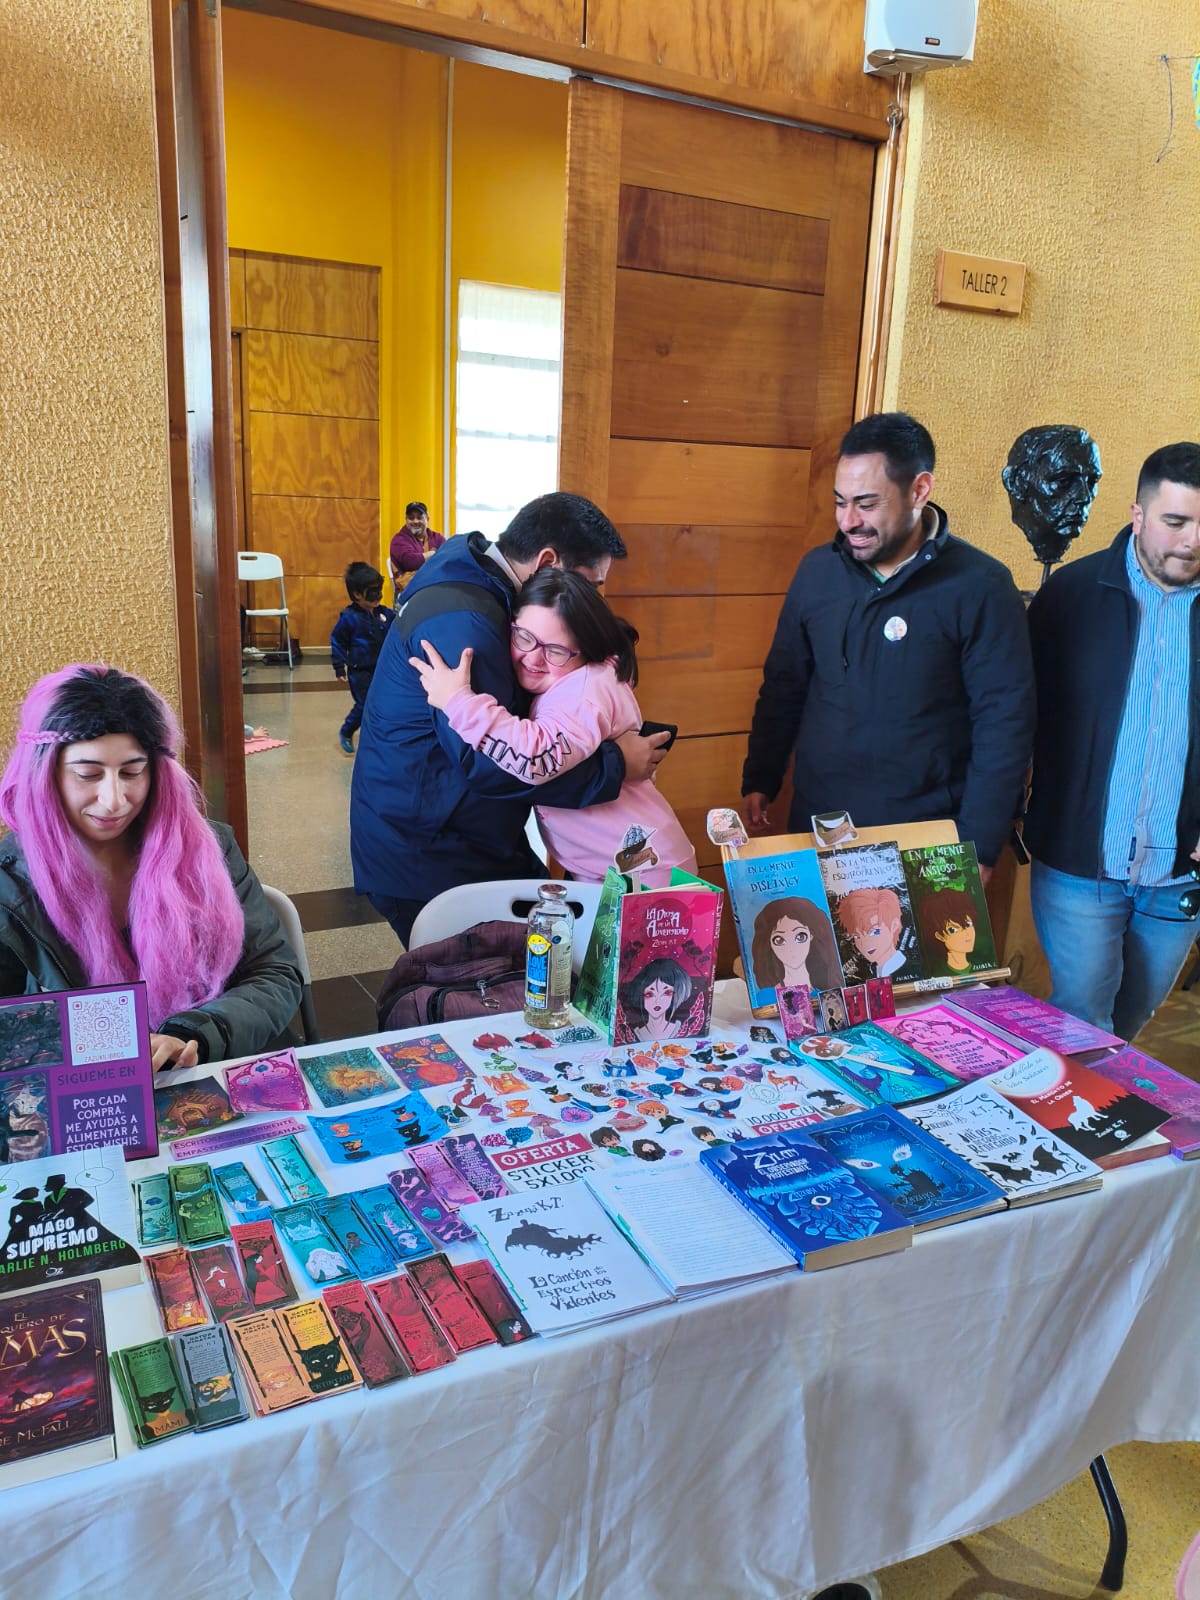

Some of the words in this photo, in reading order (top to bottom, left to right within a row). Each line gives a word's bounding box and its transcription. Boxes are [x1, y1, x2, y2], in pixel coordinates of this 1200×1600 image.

[961, 269, 998, 295] TALLER
[1000, 276, 1008, 296] 2
[908, 849, 922, 861] EN
[936, 844, 966, 857] MENTE
[57, 1067, 115, 1087] SIGUEME
[119, 1065, 137, 1078] EN
[73, 1098, 96, 1110] POR
[98, 1094, 128, 1106] CADA
[65, 1122, 82, 1134] ME
[85, 1114, 127, 1131] AYUDAS
[130, 1113, 138, 1124] A
[758, 1116, 818, 1135] OFERTA
[66, 1126, 128, 1145] ALIMENTAR
[131, 1124, 139, 1135] A
[66, 1141, 100, 1154] ESTOS
[500, 1139, 582, 1166] OFERTA
[507, 1154, 595, 1182] STICKER
[28, 1216, 76, 1239] MAGO
[6, 1226, 99, 1260] SUPREMO
[40, 1254, 54, 1267] N.
[58, 1240, 127, 1262] HOLMBERG
[14, 1311, 31, 1322] EL
[49, 1313, 67, 1323] DE
